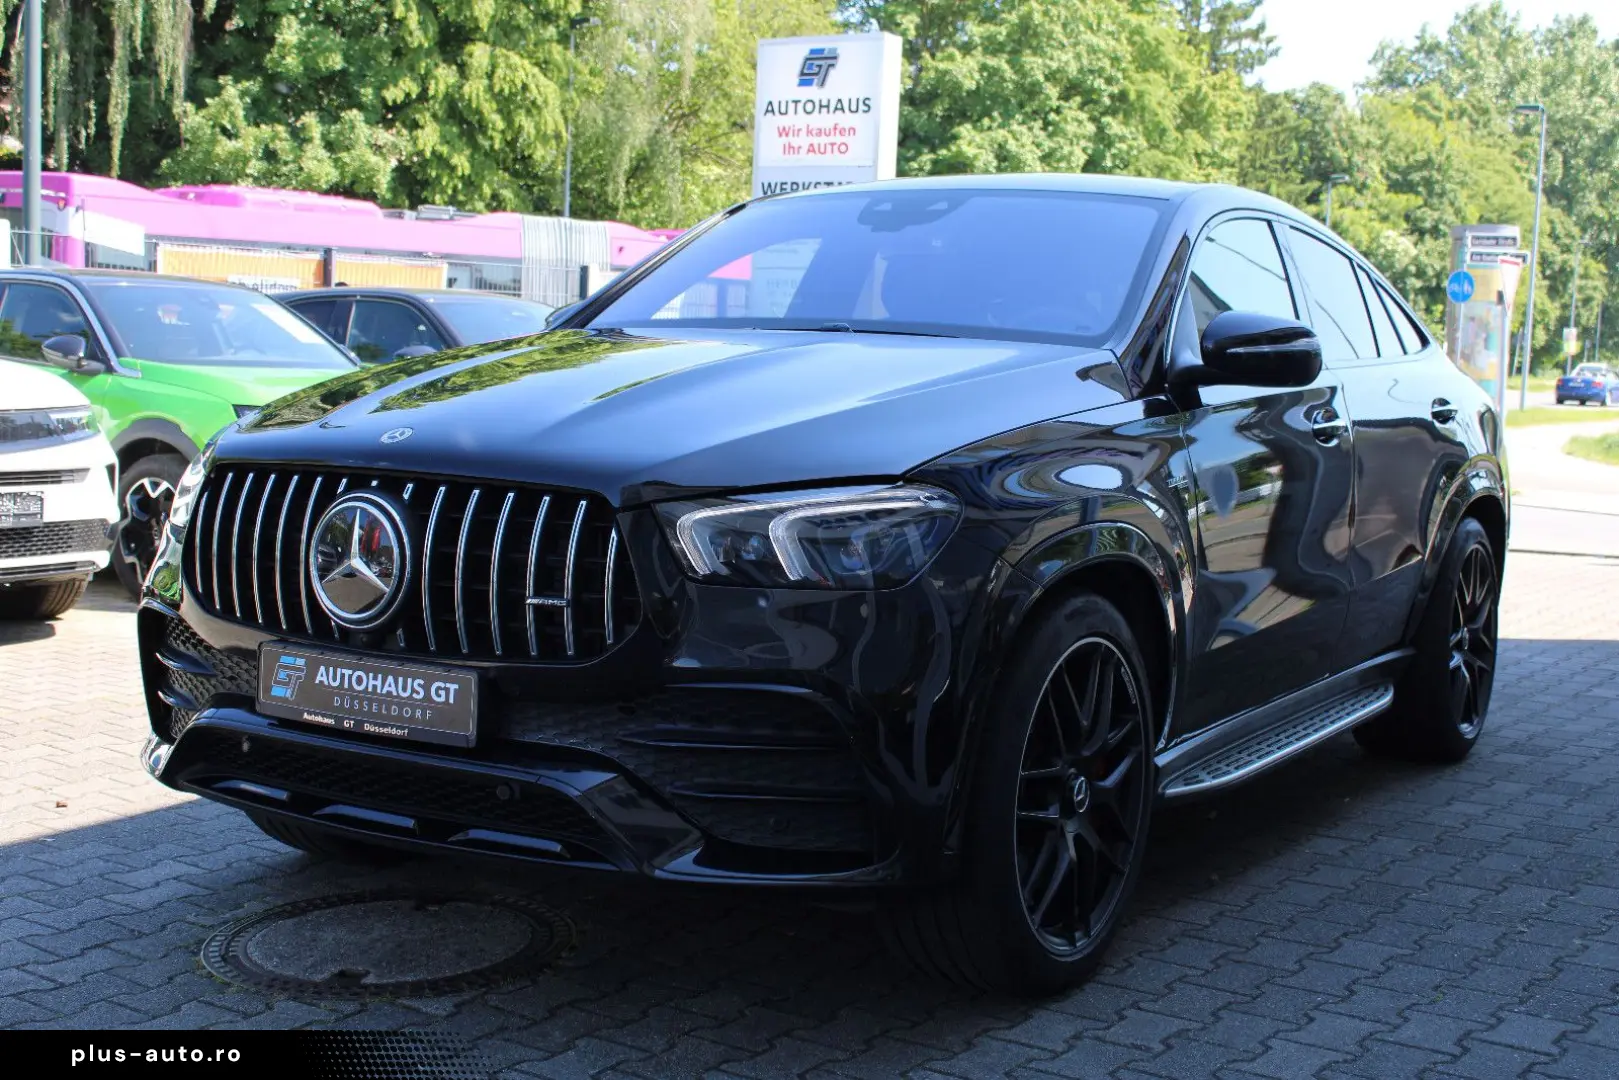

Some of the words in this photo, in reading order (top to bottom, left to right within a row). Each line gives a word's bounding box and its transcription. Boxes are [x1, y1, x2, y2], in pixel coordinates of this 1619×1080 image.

[764, 97, 872, 116] AUTOHAUS
[777, 124, 802, 138] Wir
[806, 122, 856, 138] kaufen
[783, 144, 802, 156] Ihr
[806, 142, 849, 155] AUTO
[314, 665, 425, 699] AUTOHAUS
[430, 682, 459, 704] GT
[333, 696, 432, 720] DÜSSELDORF
[302, 712, 335, 726] Autohaus
[343, 719, 355, 729] GT
[363, 723, 409, 737] Düsseldorf
